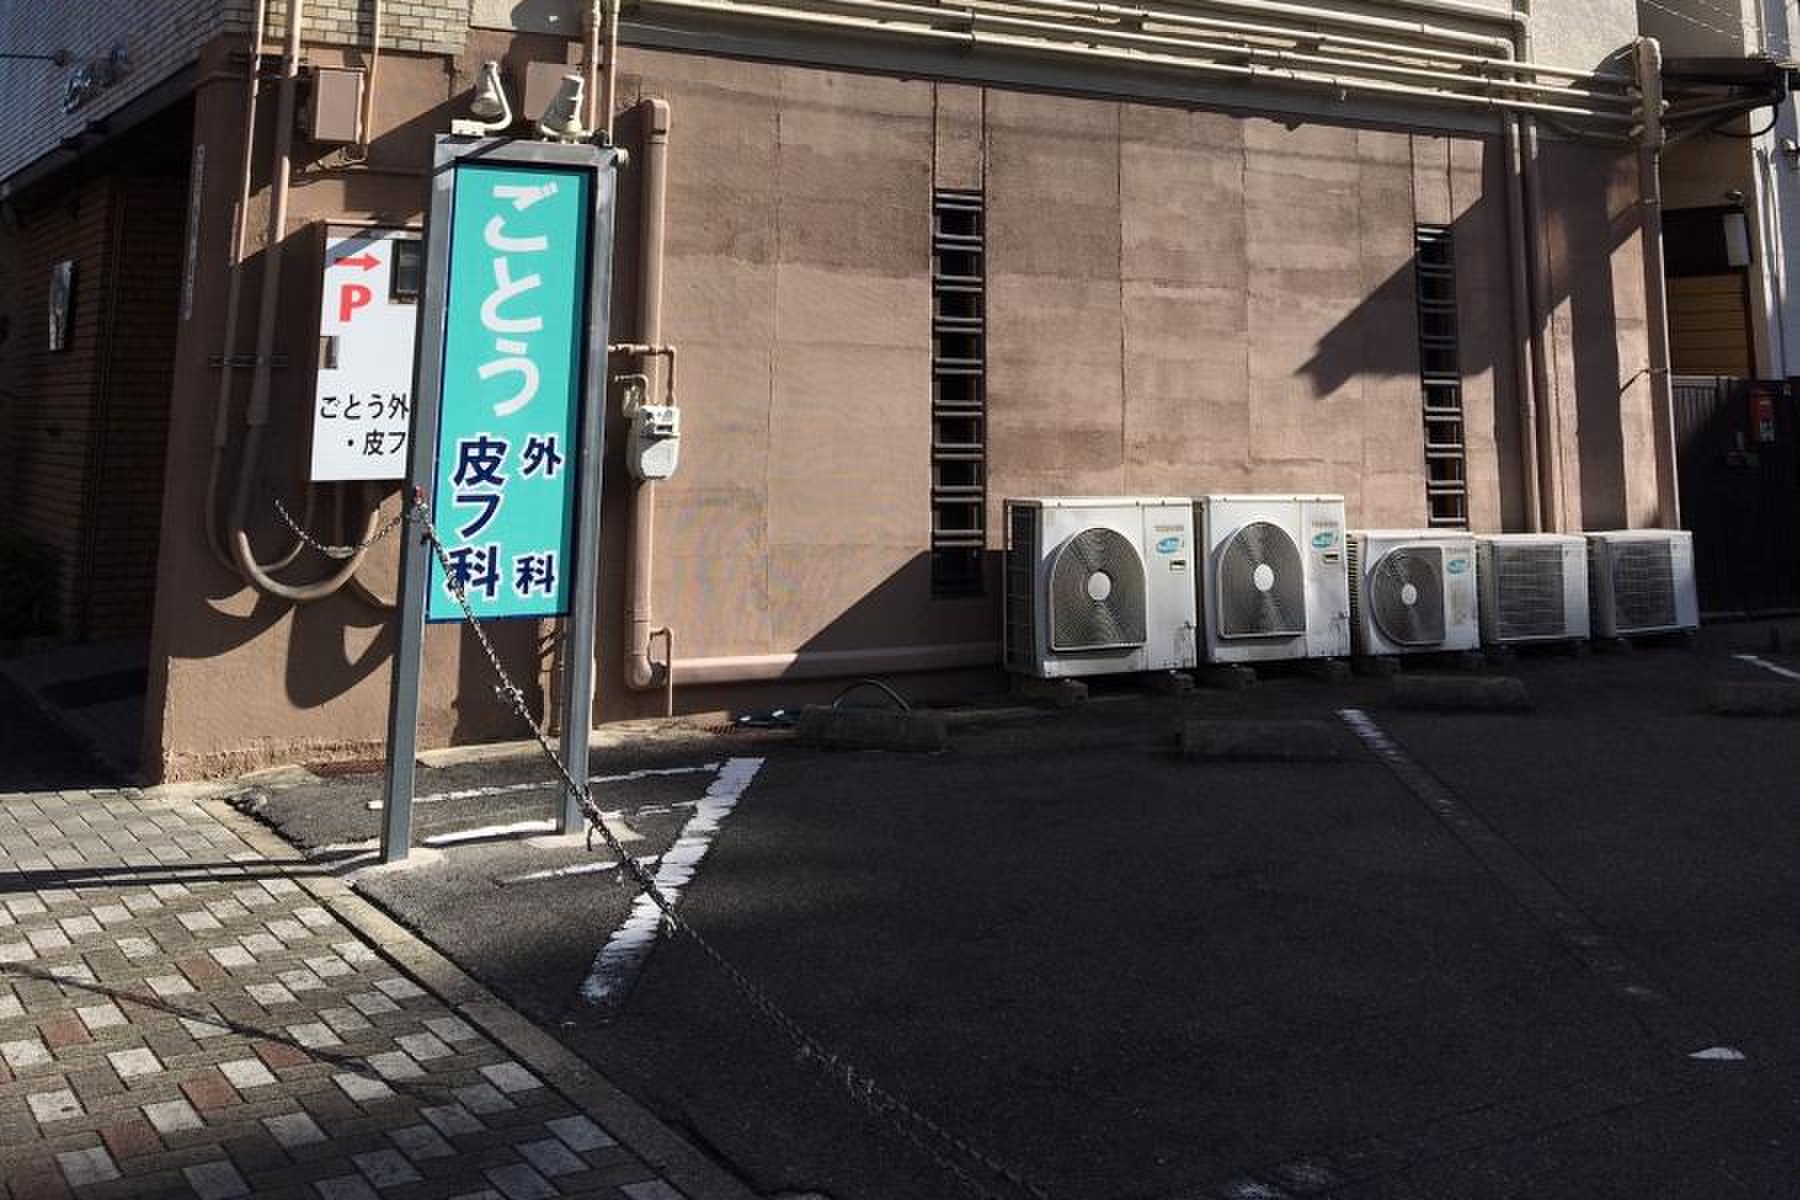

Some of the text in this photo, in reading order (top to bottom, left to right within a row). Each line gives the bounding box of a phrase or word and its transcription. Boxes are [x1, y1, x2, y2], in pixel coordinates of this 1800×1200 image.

[339, 283, 372, 322] P
[478, 181, 559, 417] ごとう
[320, 393, 409, 420] ごとう外
[447, 435, 508, 597] 皮フ科
